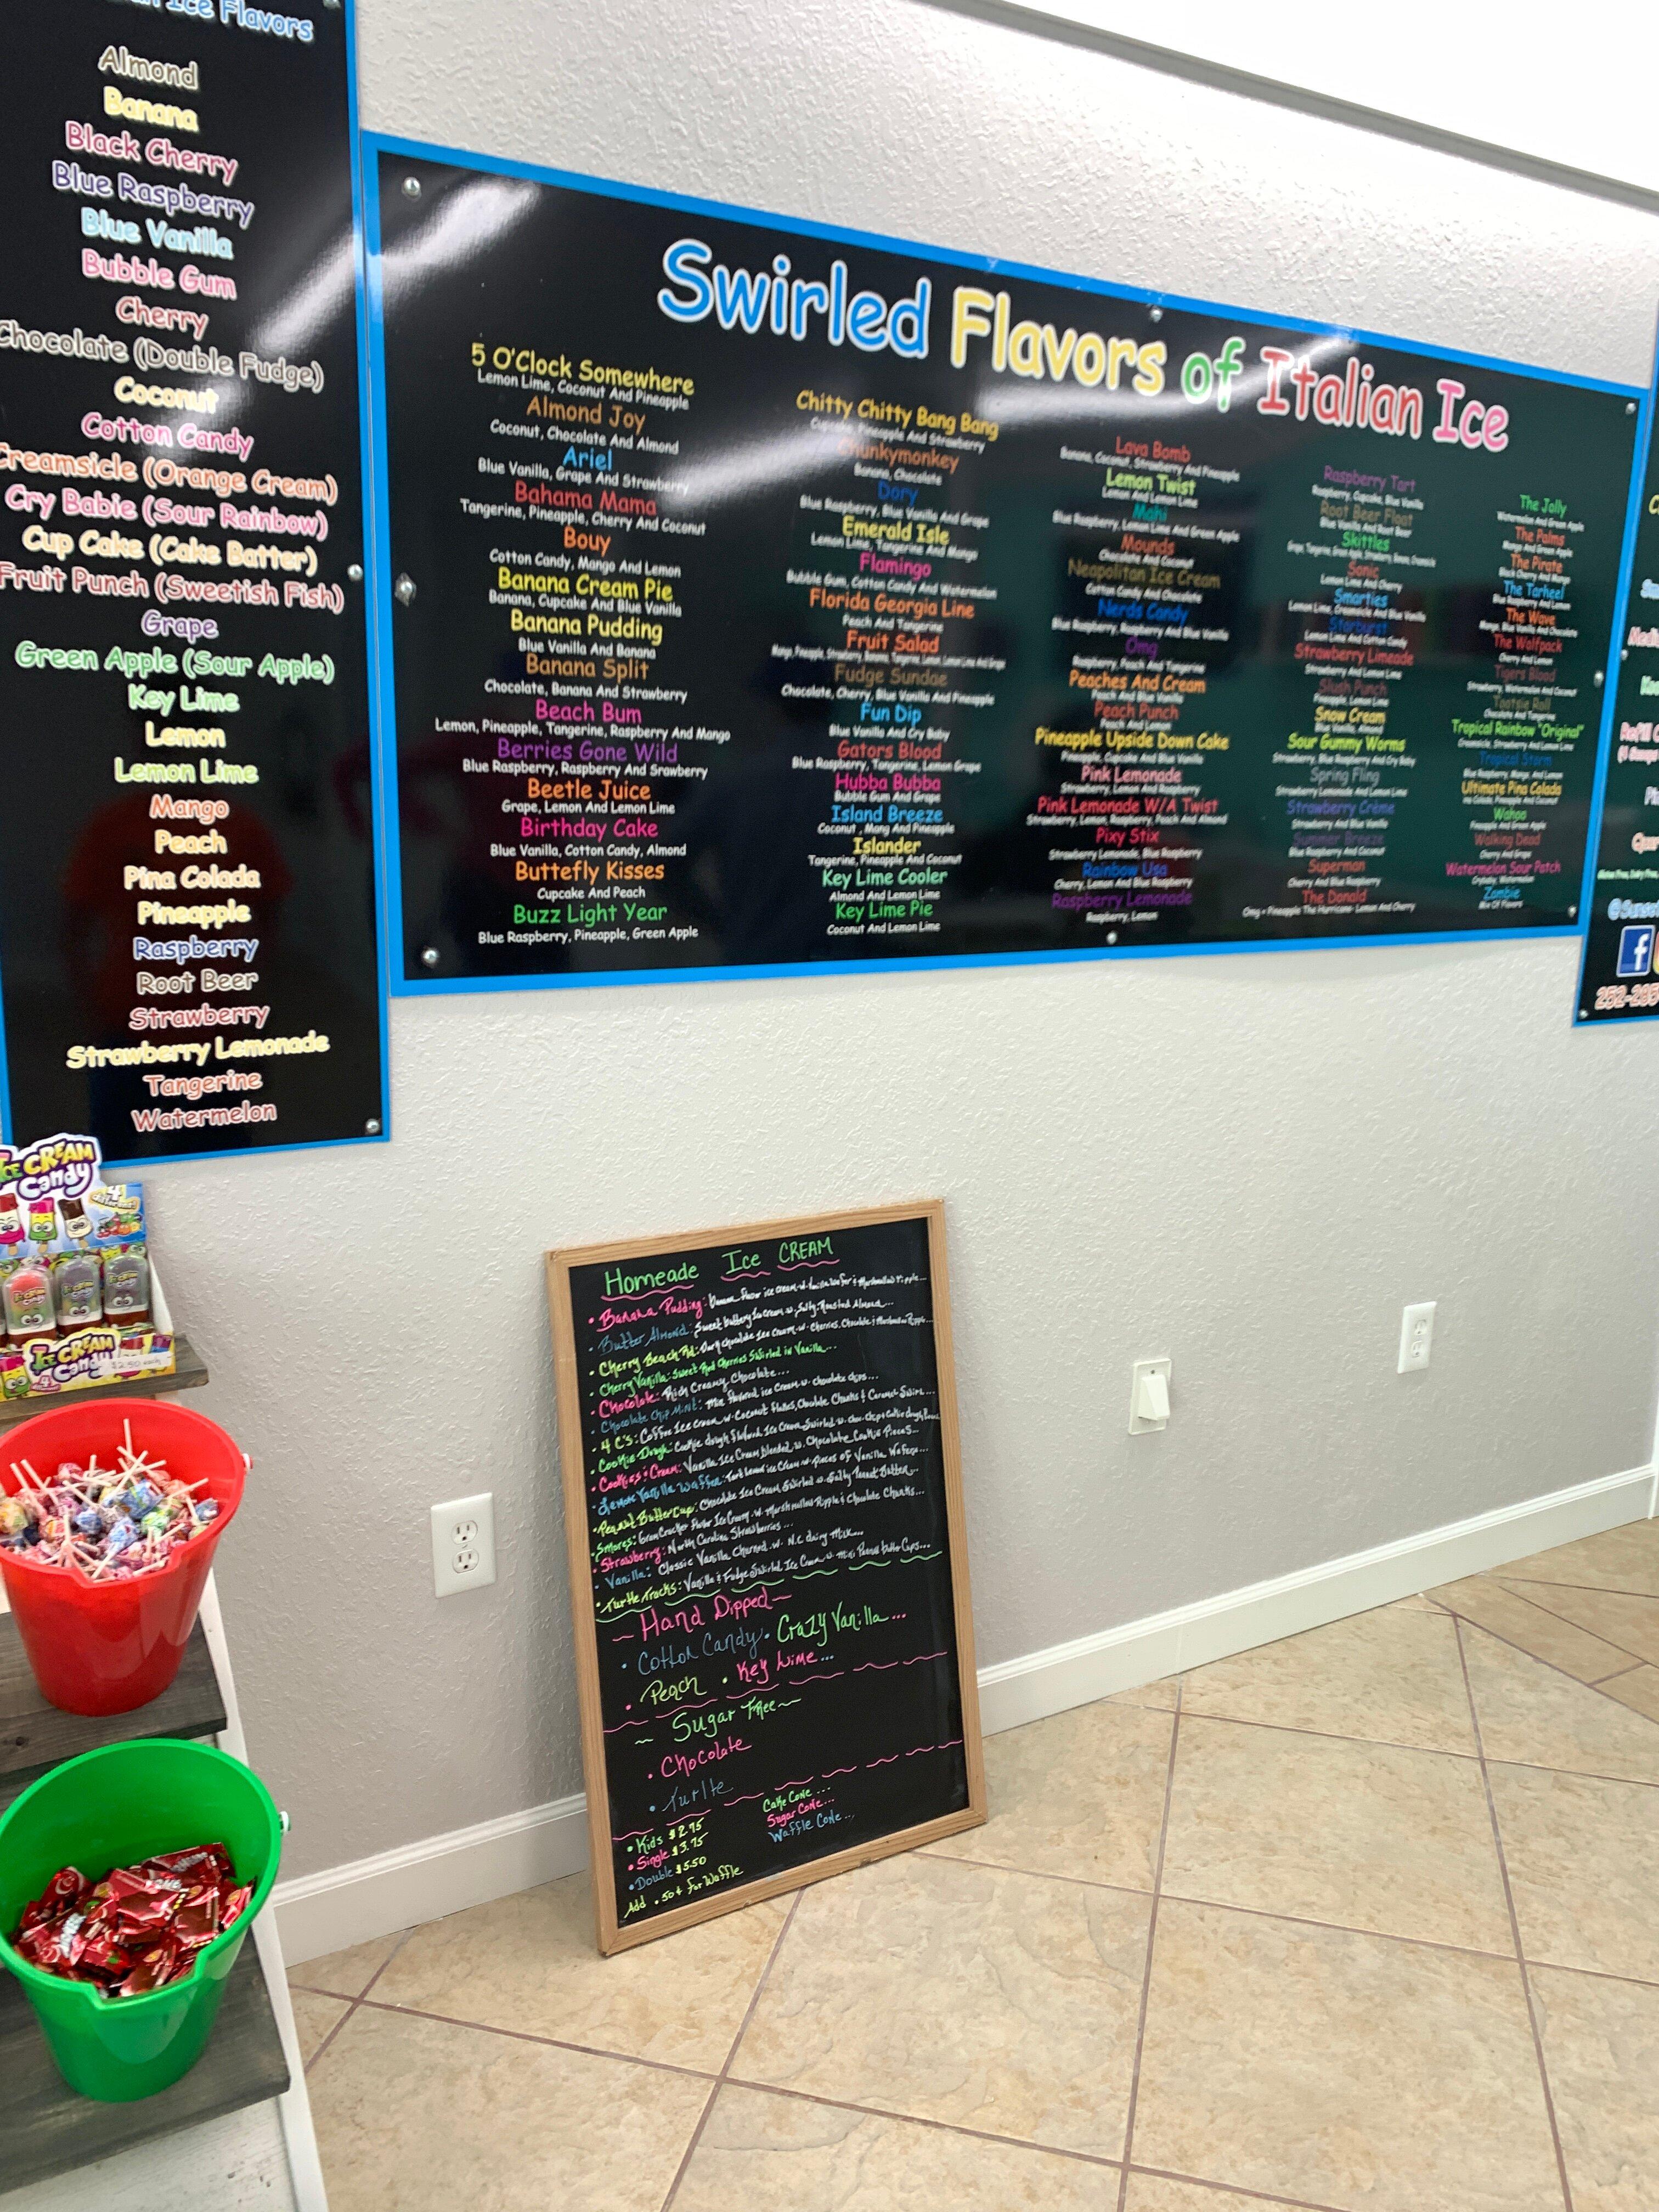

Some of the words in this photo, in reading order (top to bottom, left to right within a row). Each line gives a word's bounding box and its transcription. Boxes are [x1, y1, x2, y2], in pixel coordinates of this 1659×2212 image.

[219, 0, 313, 42] Flavors
[98, 46, 199, 91] Almond
[104, 86, 199, 132] Banana
[65, 121, 141, 162] Black
[145, 138, 238, 186] Cherry
[52, 160, 114, 198] Blue
[118, 172, 254, 229] Raspberry
[81, 207, 142, 244] Blue
[145, 218, 234, 259] Vanilla
[82, 249, 175, 289] Bubble
[179, 264, 236, 300] Gum
[116, 296, 208, 341] Cherry
[657, 237, 929, 358] Swirled
[950, 287, 1167, 397] Flavors
[1177, 337, 1248, 413] of
[1251, 343, 1423, 439] Italian
[1432, 379, 1509, 452] Ice
[133, 337, 234, 376] (Double
[239, 348, 324, 393] Fudge)
[472, 343, 485, 366] 5
[493, 347, 572, 379] O'Clock
[579, 360, 694, 399] Somewhere
[114, 376, 221, 414] Coconut
[478, 368, 518, 387] Lemon
[521, 374, 554, 393] Lime,
[557, 380, 606, 398] Coconut
[610, 387, 633, 402] And
[636, 388, 689, 411] Pineapple
[527, 396, 601, 424] Almond
[609, 405, 645, 435] Joy
[81, 412, 173, 448] Cotton
[177, 423, 254, 462] Candy
[563, 446, 612, 471] Ariel
[143, 456, 247, 498] (Orange
[251, 469, 338, 506] Cream)
[515, 476, 592, 509] Bahama
[599, 491, 657, 516] Mama
[5, 484, 57, 521] Cry
[62, 488, 138, 520] Babie
[142, 495, 215, 527] (Sour
[220, 503, 328, 541] Rainbow)
[22, 525, 74, 561] Cup
[79, 529, 145, 560] Cake
[149, 534, 222, 566] (Cake
[227, 540, 318, 577] Batter)
[563, 526, 611, 557] Bouy
[860, 552, 931, 581] Flamingo
[72, 566, 150, 598] Punch
[154, 572, 279, 606] (Sweetish
[284, 581, 344, 614] Fish)
[499, 565, 573, 594] Banana
[576, 574, 638, 599] Cream
[645, 578, 673, 602] Pie
[141, 609, 219, 645] Grape
[511, 608, 581, 635] Banana
[588, 614, 662, 646] Pudding
[15, 641, 99, 670] Green
[104, 646, 178, 679] Apple
[182, 647, 253, 679] (Sour
[257, 653, 335, 685] Apple)
[527, 652, 595, 677] Banana
[603, 658, 649, 684] Split
[128, 684, 176, 716] Key
[180, 685, 240, 713] Lime
[536, 699, 594, 721] Beach
[603, 702, 641, 724] Bum
[860, 702, 890, 723] Fun
[895, 704, 922, 730] Dip
[145, 721, 226, 748] Lemon
[498, 738, 572, 760] Berries
[579, 740, 627, 761] Gone
[635, 743, 677, 763] Wild
[1035, 727, 1102, 751] Pineapple
[1105, 730, 1153, 752] Upside
[1157, 732, 1194, 749] Down
[1197, 732, 1229, 750] Cake
[115, 757, 196, 783] Lemon
[200, 759, 259, 784] Lime
[528, 777, 592, 799] Beetle
[599, 780, 651, 800] Juice
[149, 794, 229, 825] Mango
[501, 799, 541, 815] Grape,
[545, 800, 582, 813] Lemon
[585, 800, 607, 813] And
[611, 801, 647, 814] Lemon
[649, 802, 675, 814] Lime
[155, 829, 227, 854] Peach
[520, 817, 607, 842] Birthday
[613, 817, 658, 837] Cake
[853, 836, 921, 859] Islander
[123, 865, 177, 890] Pina
[180, 864, 261, 889] Colada
[516, 860, 599, 885] Buttefly
[607, 861, 664, 880] Kisses
[822, 869, 851, 890] Key
[856, 868, 894, 886] Lime
[898, 867, 947, 885] Cooler
[537, 887, 584, 902] Cupcake
[588, 887, 610, 899] And
[613, 886, 645, 898] Peach
[138, 899, 251, 929] Pineapple
[514, 905, 561, 924] Buzz
[567, 902, 617, 928] Light
[624, 903, 667, 921] Year
[836, 902, 865, 922] Key
[869, 901, 906, 918] Lime
[910, 899, 934, 917] Pie
[133, 934, 259, 965] Raspberry
[137, 972, 196, 995] Root
[201, 968, 258, 992] Beer
[128, 1003, 270, 1030] Strawberry
[66, 1040, 211, 1069] Strawberry
[215, 1030, 330, 1059] Lemonade
[143, 1069, 263, 1100] Tangerine
[131, 1100, 277, 1132] Watermelon
